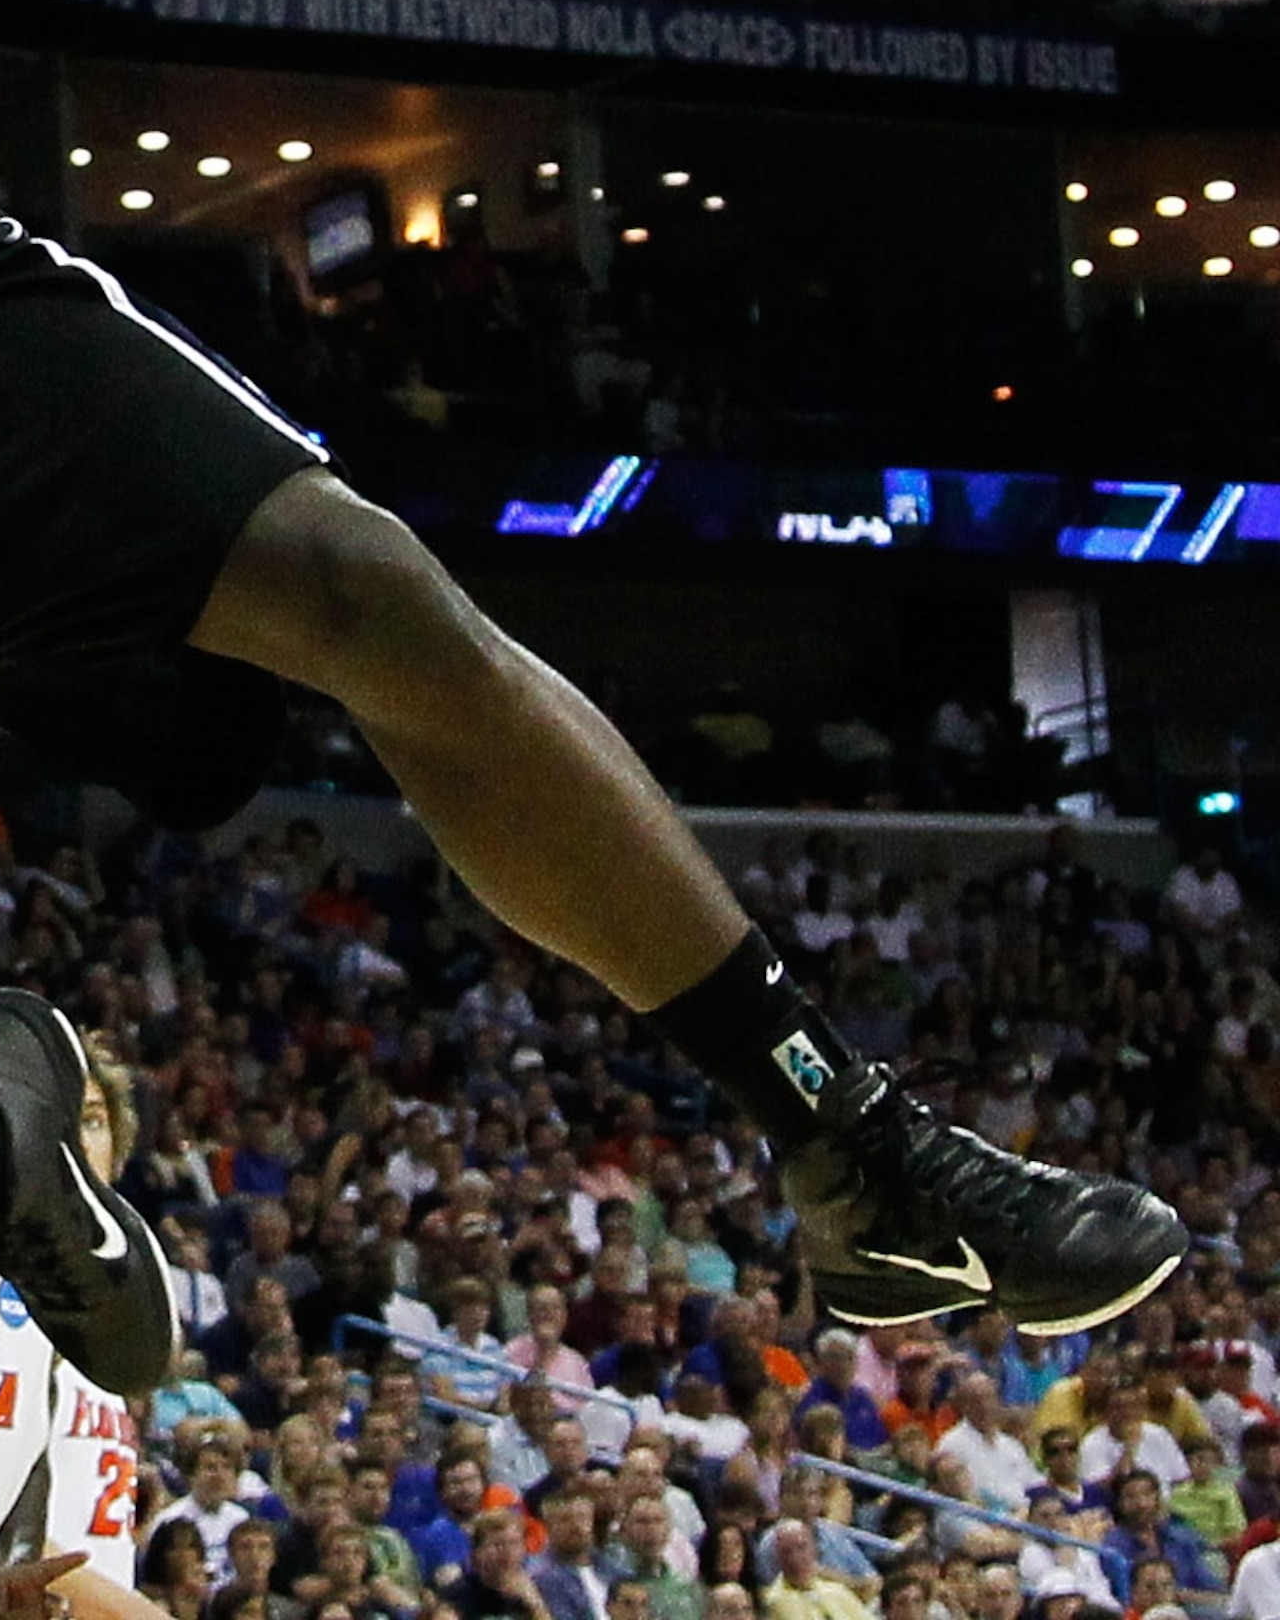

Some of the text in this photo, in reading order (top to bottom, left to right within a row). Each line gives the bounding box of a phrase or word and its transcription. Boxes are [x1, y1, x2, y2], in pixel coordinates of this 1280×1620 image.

[566, 1, 655, 57] NOLA
[804, 21, 968, 80] FOLLOWED
[974, 34, 1017, 86] BY
[1024, 39, 1117, 95] ISSUE
